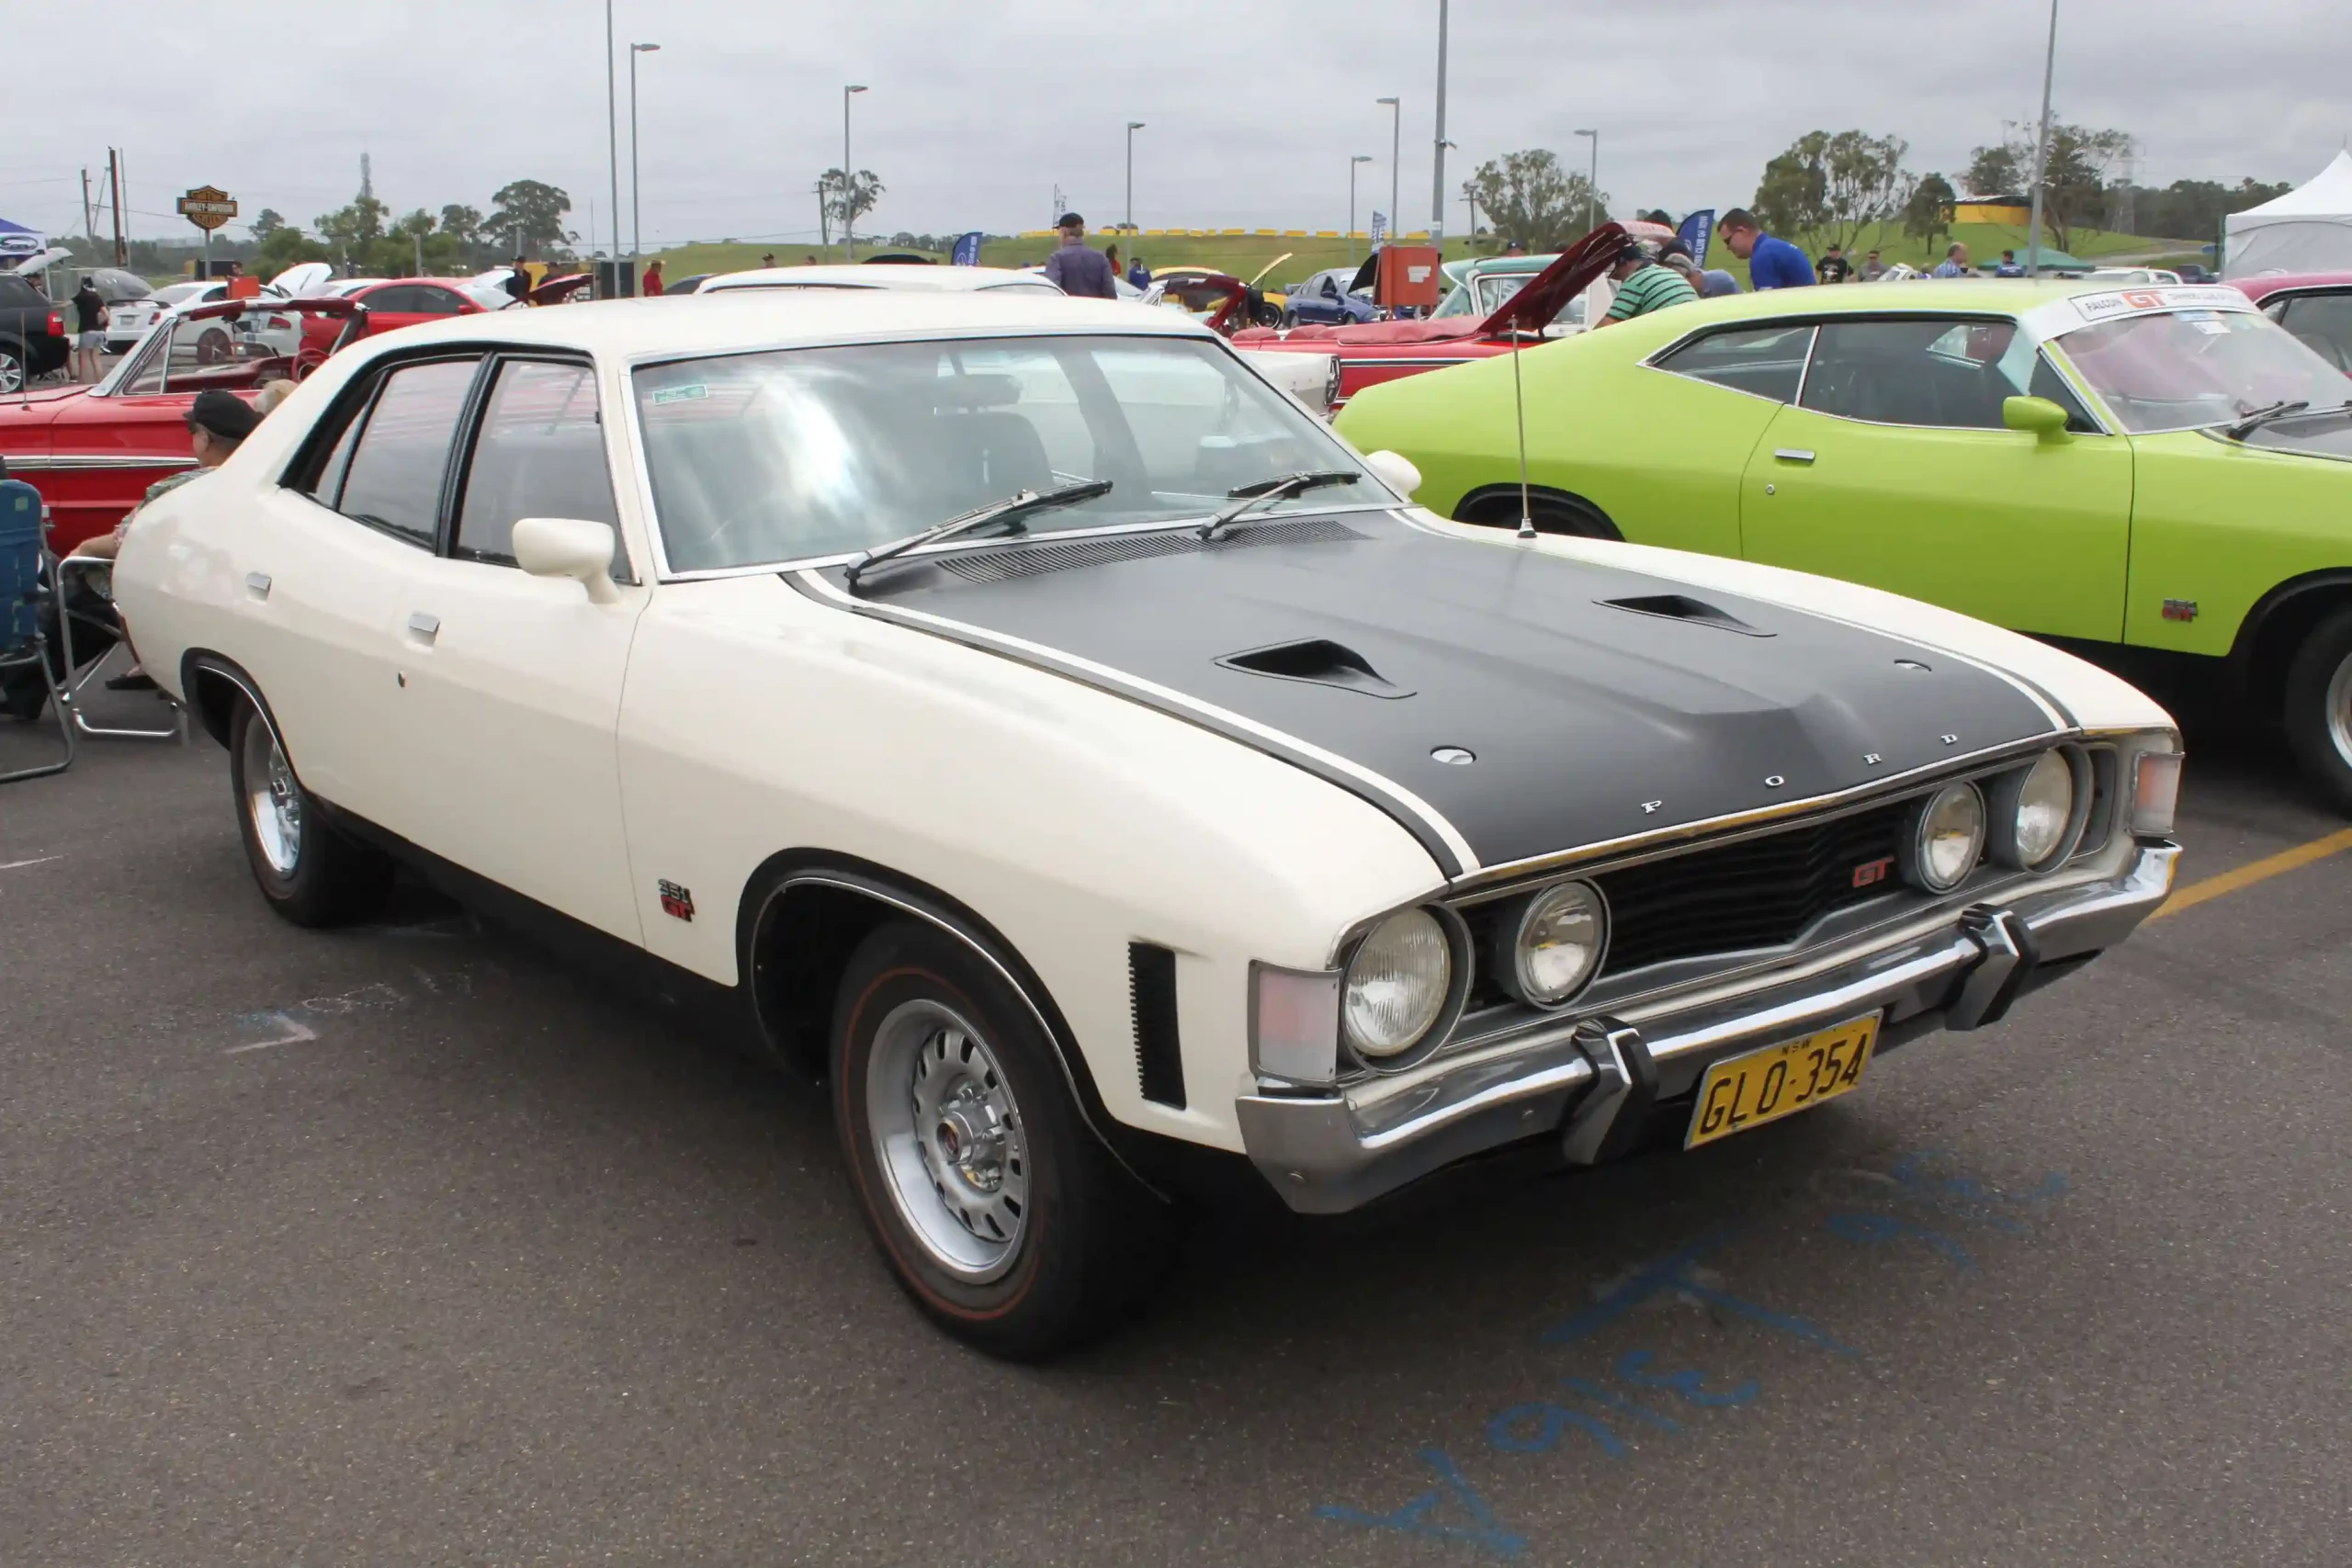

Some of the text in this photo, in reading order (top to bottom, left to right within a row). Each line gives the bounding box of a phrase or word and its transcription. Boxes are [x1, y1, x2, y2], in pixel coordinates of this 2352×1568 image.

[1695, 239, 1705, 254] CLUB
[2085, 299, 2123, 312] FALCON
[2121, 289, 2165, 310] GT
[1852, 855, 1895, 888] GT
[658, 878, 691, 905] 351
[661, 894, 695, 923] GT
[1781, 1036, 1813, 1055] NSW
